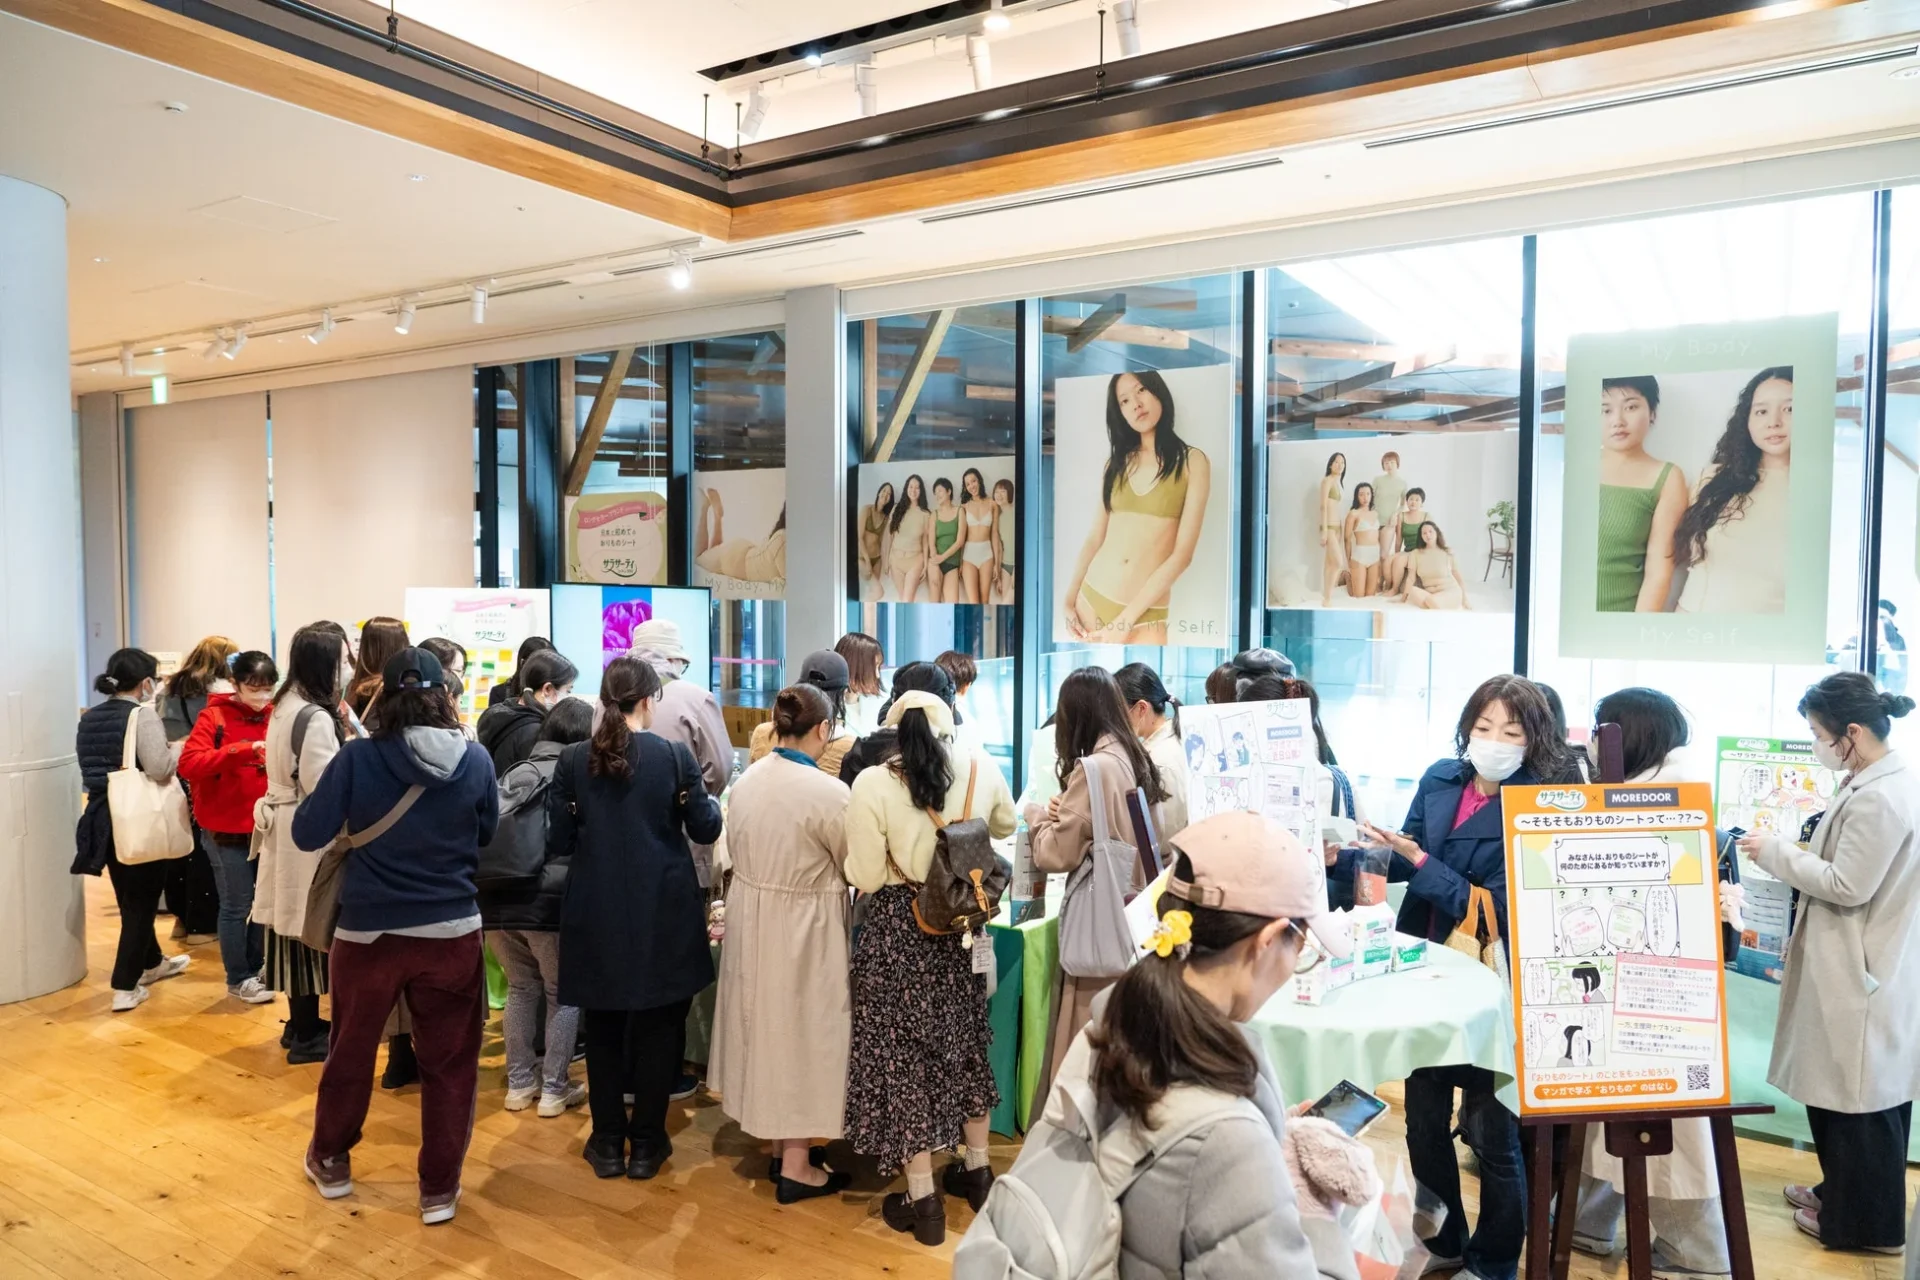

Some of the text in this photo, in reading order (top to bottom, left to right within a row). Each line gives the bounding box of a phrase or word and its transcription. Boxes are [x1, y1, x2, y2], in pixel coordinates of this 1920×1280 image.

[600, 539, 636, 547] おりものシート
[602, 558, 637, 569] サラサーティ
[704, 577, 721, 592] My
[1178, 619, 1219, 635] Self.
[1540, 791, 1582, 802] サラサーティ
[1611, 792, 1672, 803] MOREDOOR
[1567, 852, 1659, 862] みなさんは、おりものシートが
[1559, 860, 1667, 870] 何のためにあるか知っていますか?
